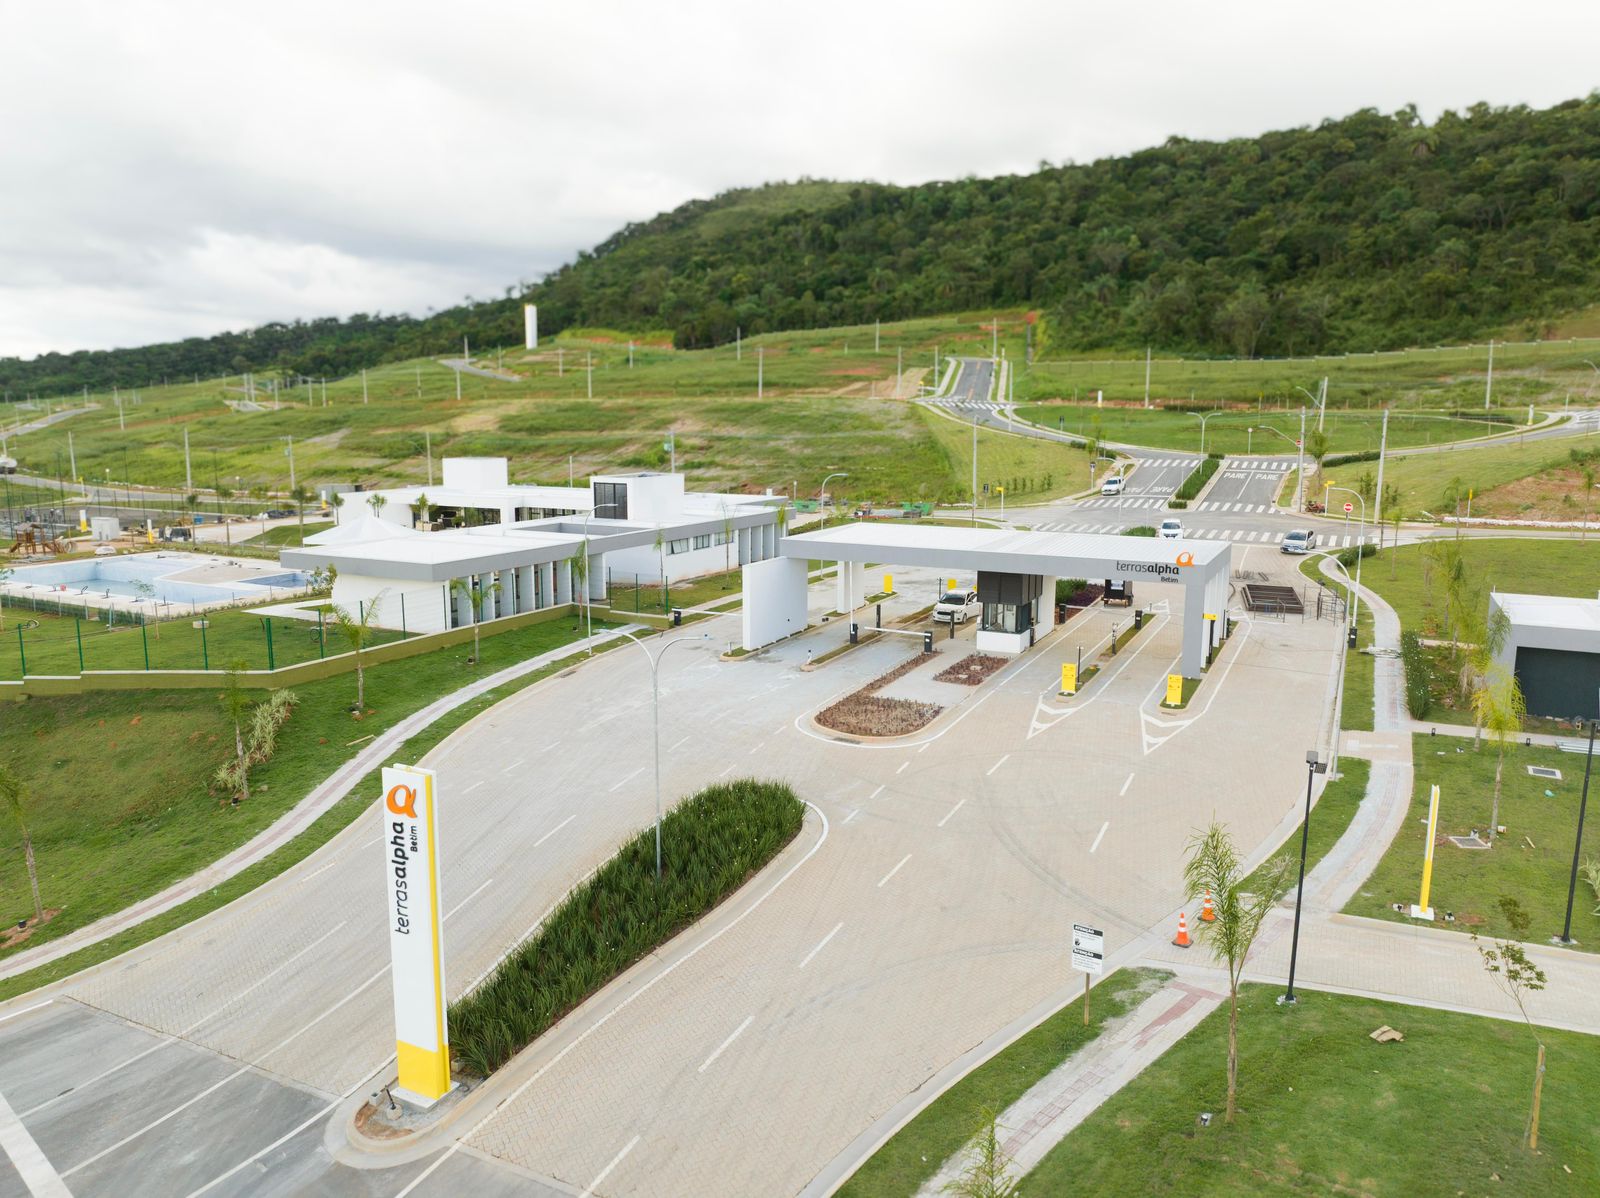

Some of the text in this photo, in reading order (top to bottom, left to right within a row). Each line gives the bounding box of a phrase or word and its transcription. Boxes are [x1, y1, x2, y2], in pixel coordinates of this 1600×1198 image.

[1116, 561, 1179, 575] terrasalpha
[410, 825, 418, 852] Betim
[391, 821, 410, 935] terrasalpha
